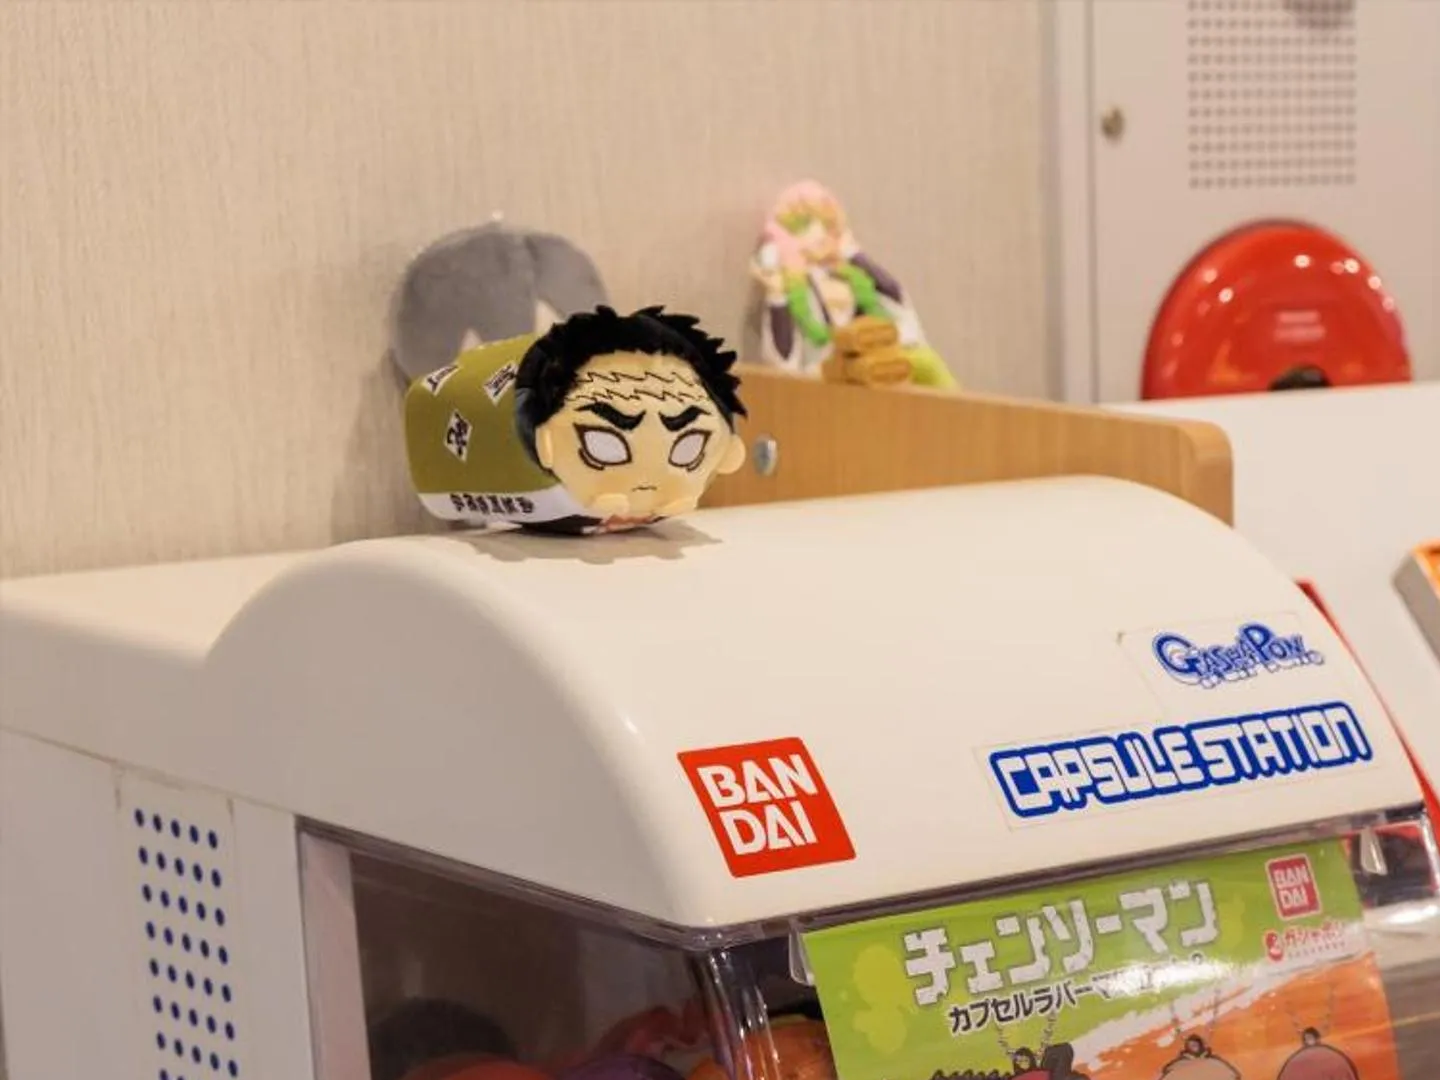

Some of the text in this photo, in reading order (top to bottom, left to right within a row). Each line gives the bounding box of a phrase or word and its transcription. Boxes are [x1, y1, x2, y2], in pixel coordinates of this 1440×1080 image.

[697, 754, 818, 808] BAN
[719, 800, 818, 856] DAI
[904, 881, 1218, 1005] チェンソーマン
